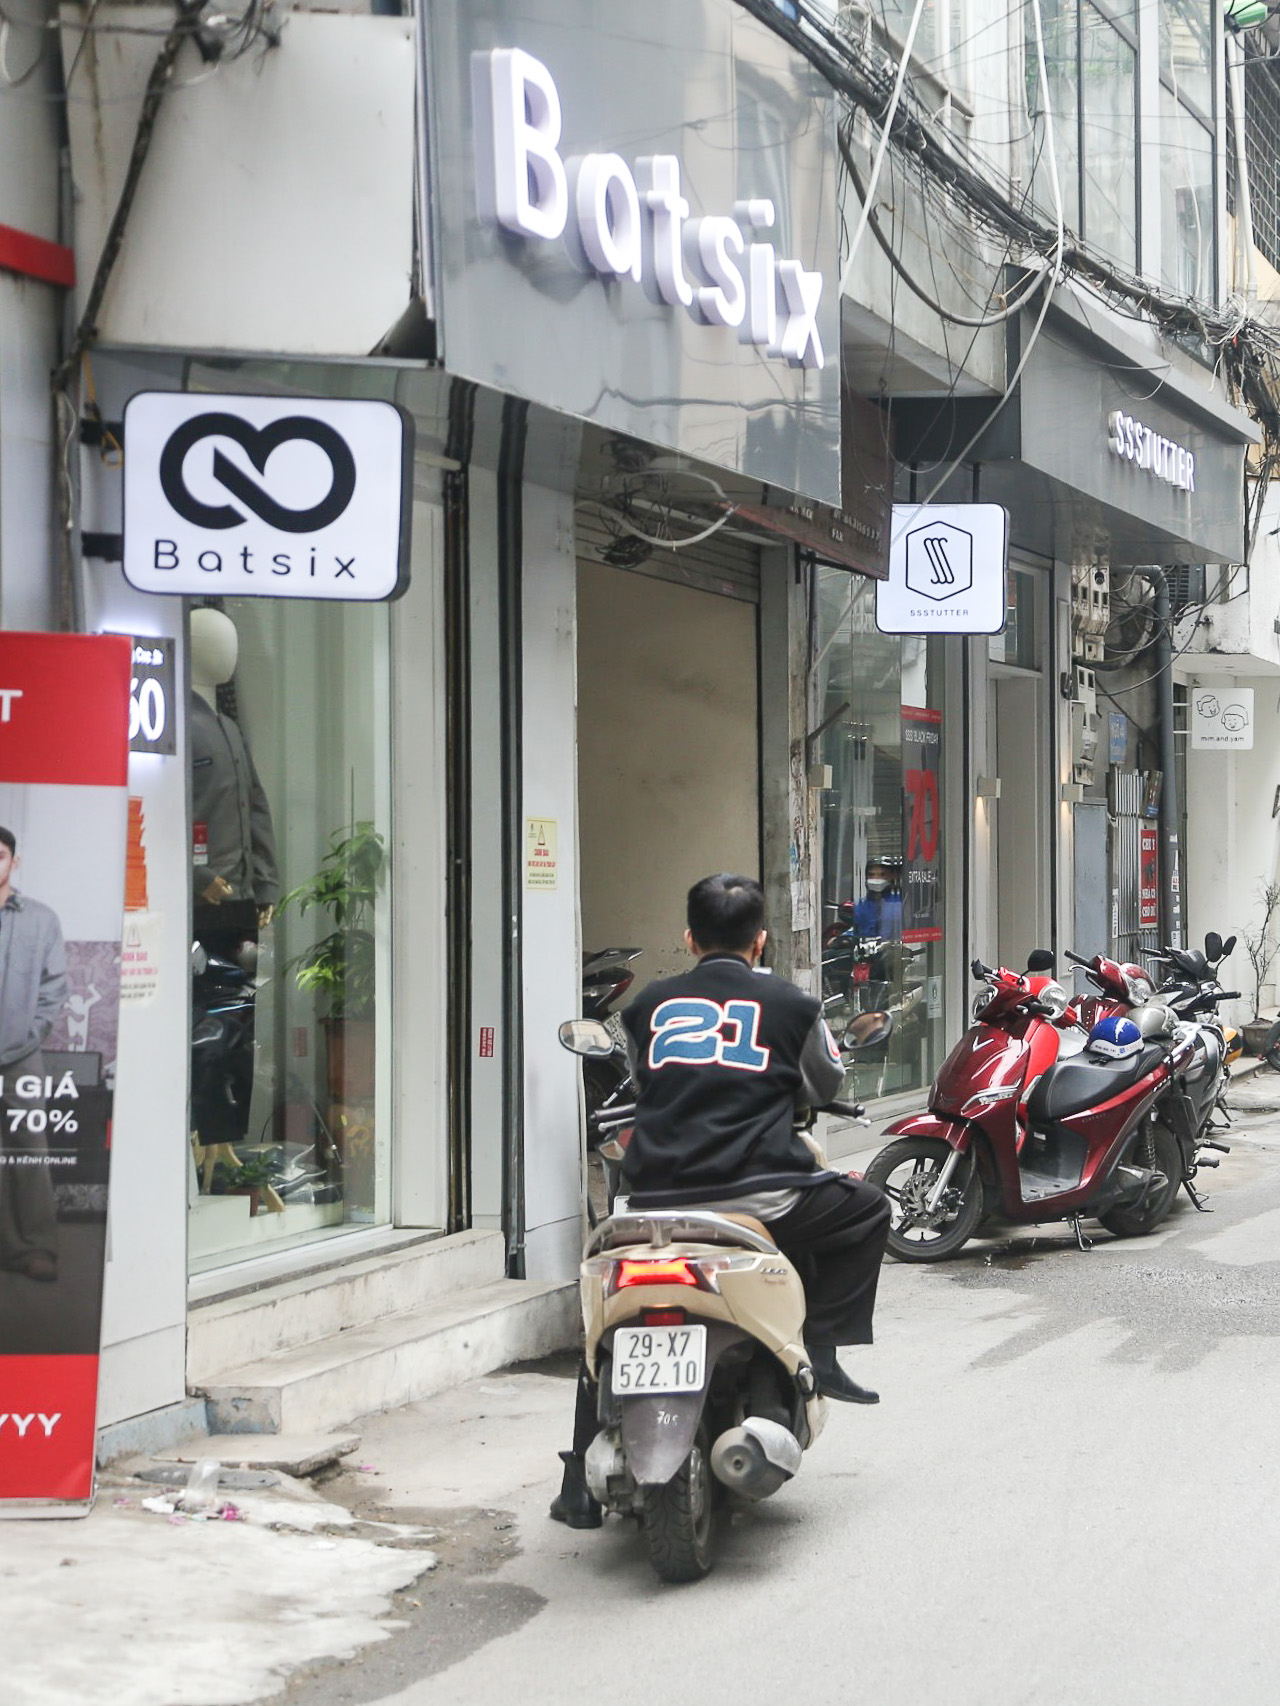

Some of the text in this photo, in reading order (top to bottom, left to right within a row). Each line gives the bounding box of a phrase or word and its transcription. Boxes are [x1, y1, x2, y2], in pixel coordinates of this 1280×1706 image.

[472, 47, 825, 370] Batsix
[1110, 410, 1195, 493] SSSTUTTER
[153, 538, 356, 579] Batsix
[910, 609, 969, 617] SSSTUTTER
[905, 769, 938, 862] 70
[648, 997, 770, 1071] 21
[15, 1071, 79, 1099] GIÁ
[6, 1109, 79, 1133] 70%
[43, 1156, 78, 1165] ONLINE
[629, 1332, 691, 1359] 29-X7
[620, 1360, 697, 1388] 522.10
